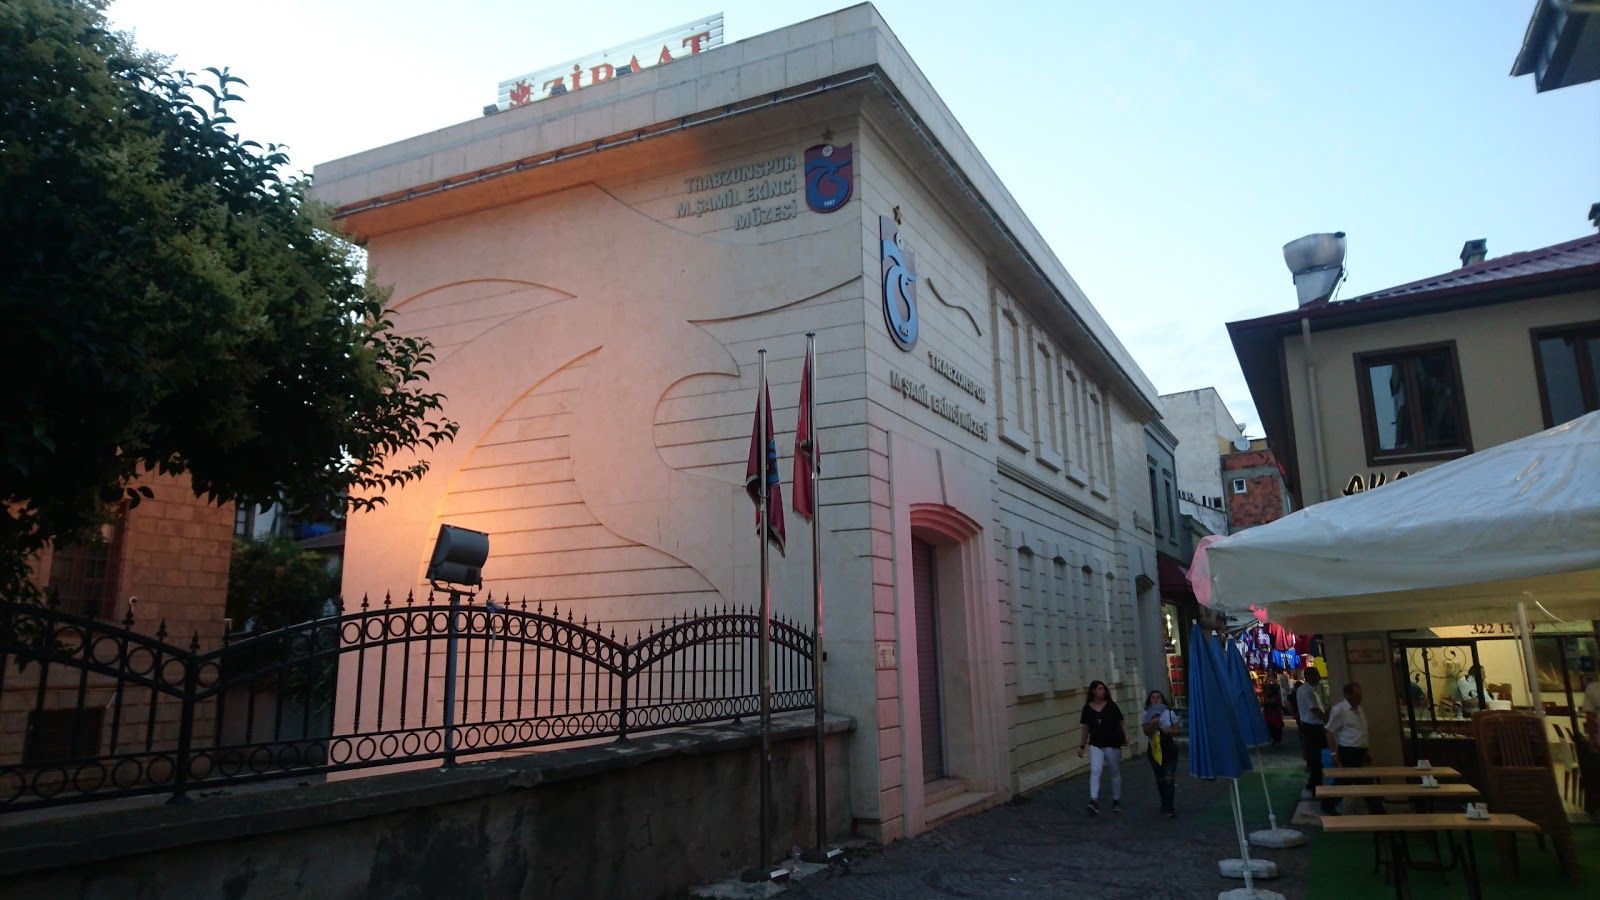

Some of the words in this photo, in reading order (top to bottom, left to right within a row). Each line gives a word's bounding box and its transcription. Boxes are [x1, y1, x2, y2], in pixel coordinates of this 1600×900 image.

[747, 175, 796, 202] EKİNCİ
[735, 200, 797, 230] MÜZESİ
[928, 351, 986, 404] TRABZONSPOR
[1471, 623, 1495, 634] 322
